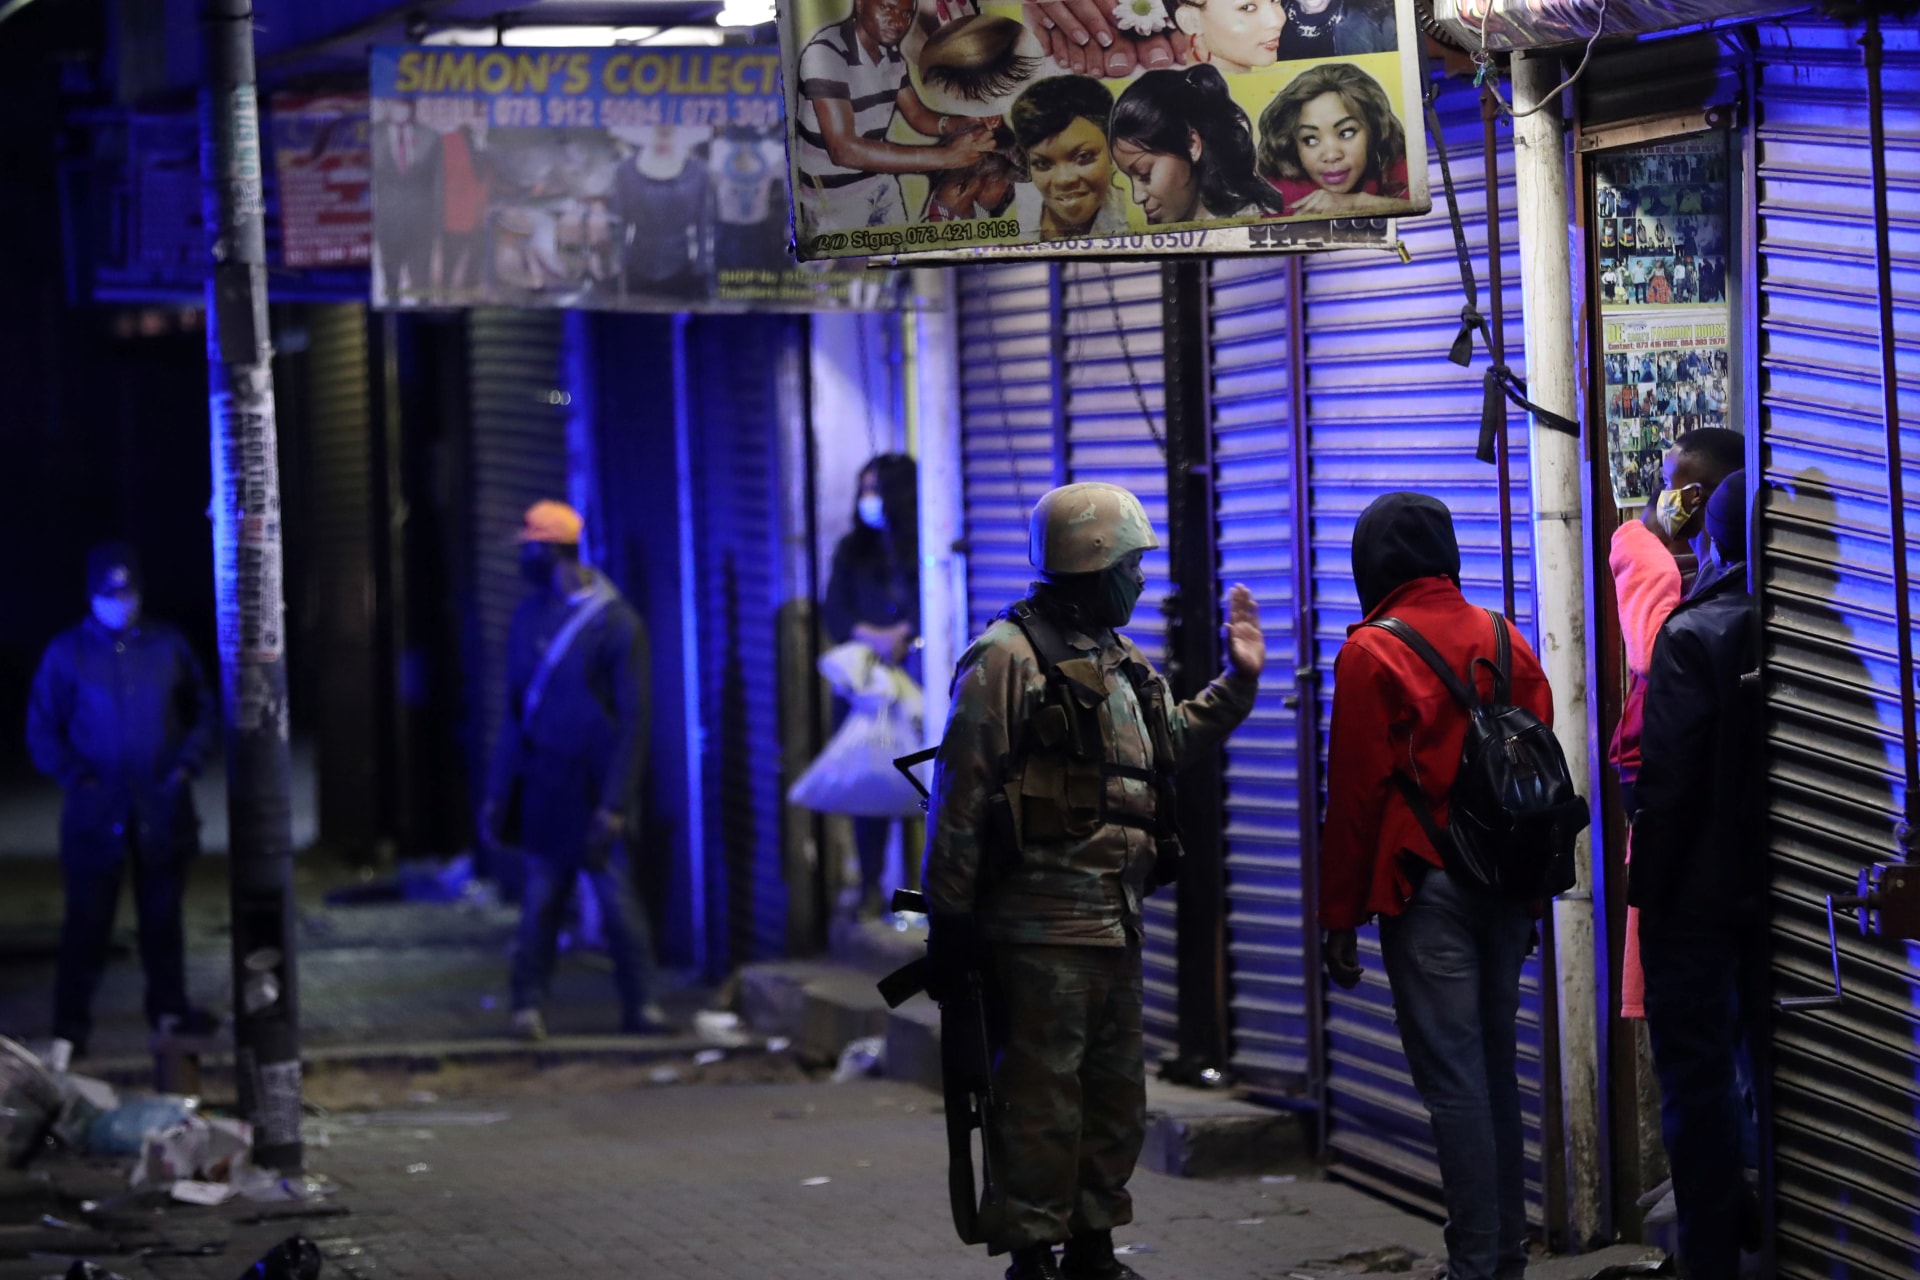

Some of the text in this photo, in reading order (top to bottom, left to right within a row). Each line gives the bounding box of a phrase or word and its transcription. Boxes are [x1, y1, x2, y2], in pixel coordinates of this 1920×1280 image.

[395, 53, 591, 94] SIMON'S
[851, 231, 902, 249] Signs
[906, 226, 939, 244] 073
[942, 223, 973, 241] 421
[977, 220, 1020, 239] 8193
[1650, 326, 1693, 340] FASHION
[1694, 323, 1727, 338] HOUSE
[247, 412, 266, 515] ABORTION
